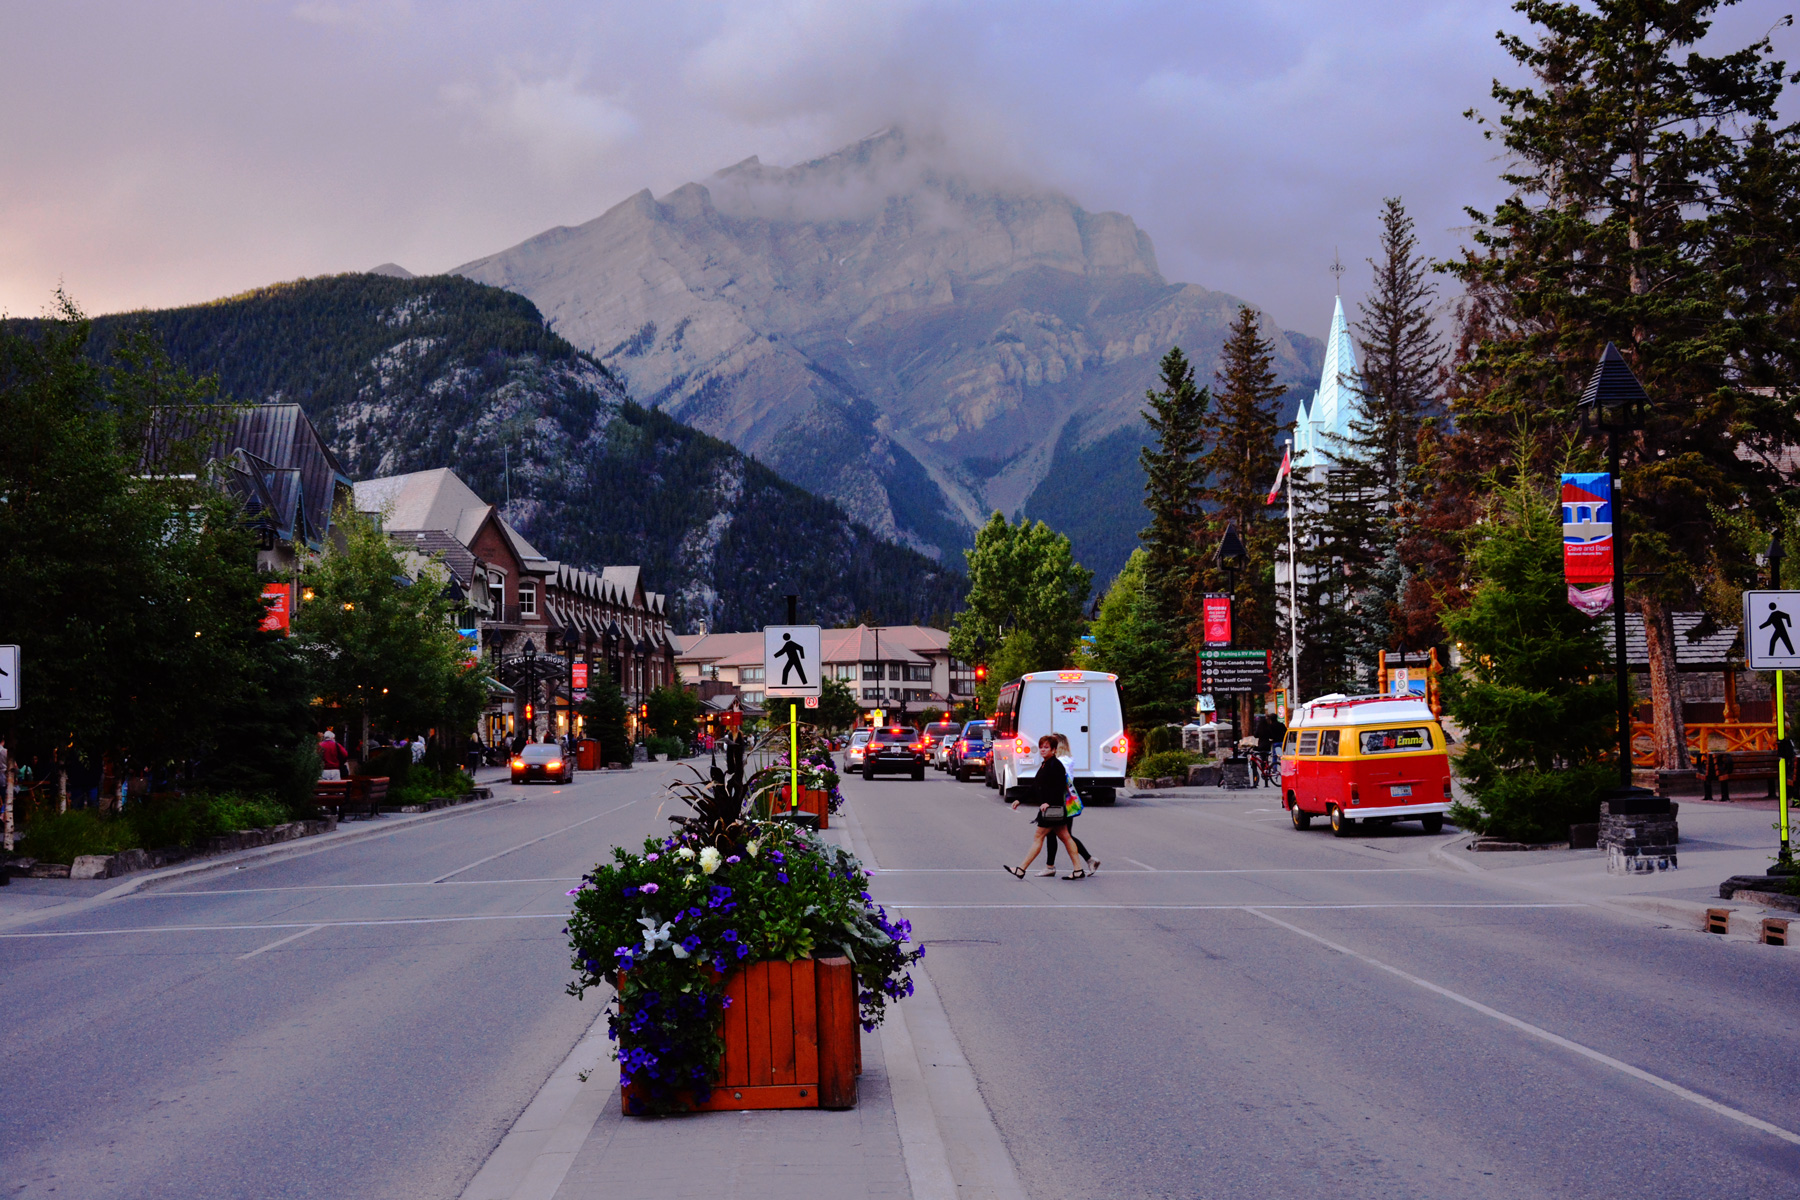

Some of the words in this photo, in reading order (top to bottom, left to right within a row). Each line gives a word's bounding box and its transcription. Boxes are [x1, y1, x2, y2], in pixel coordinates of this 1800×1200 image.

[544, 656, 566, 666] SHOPS
[1383, 736, 1395, 748] Big
[1397, 736, 1424, 745] Emma
